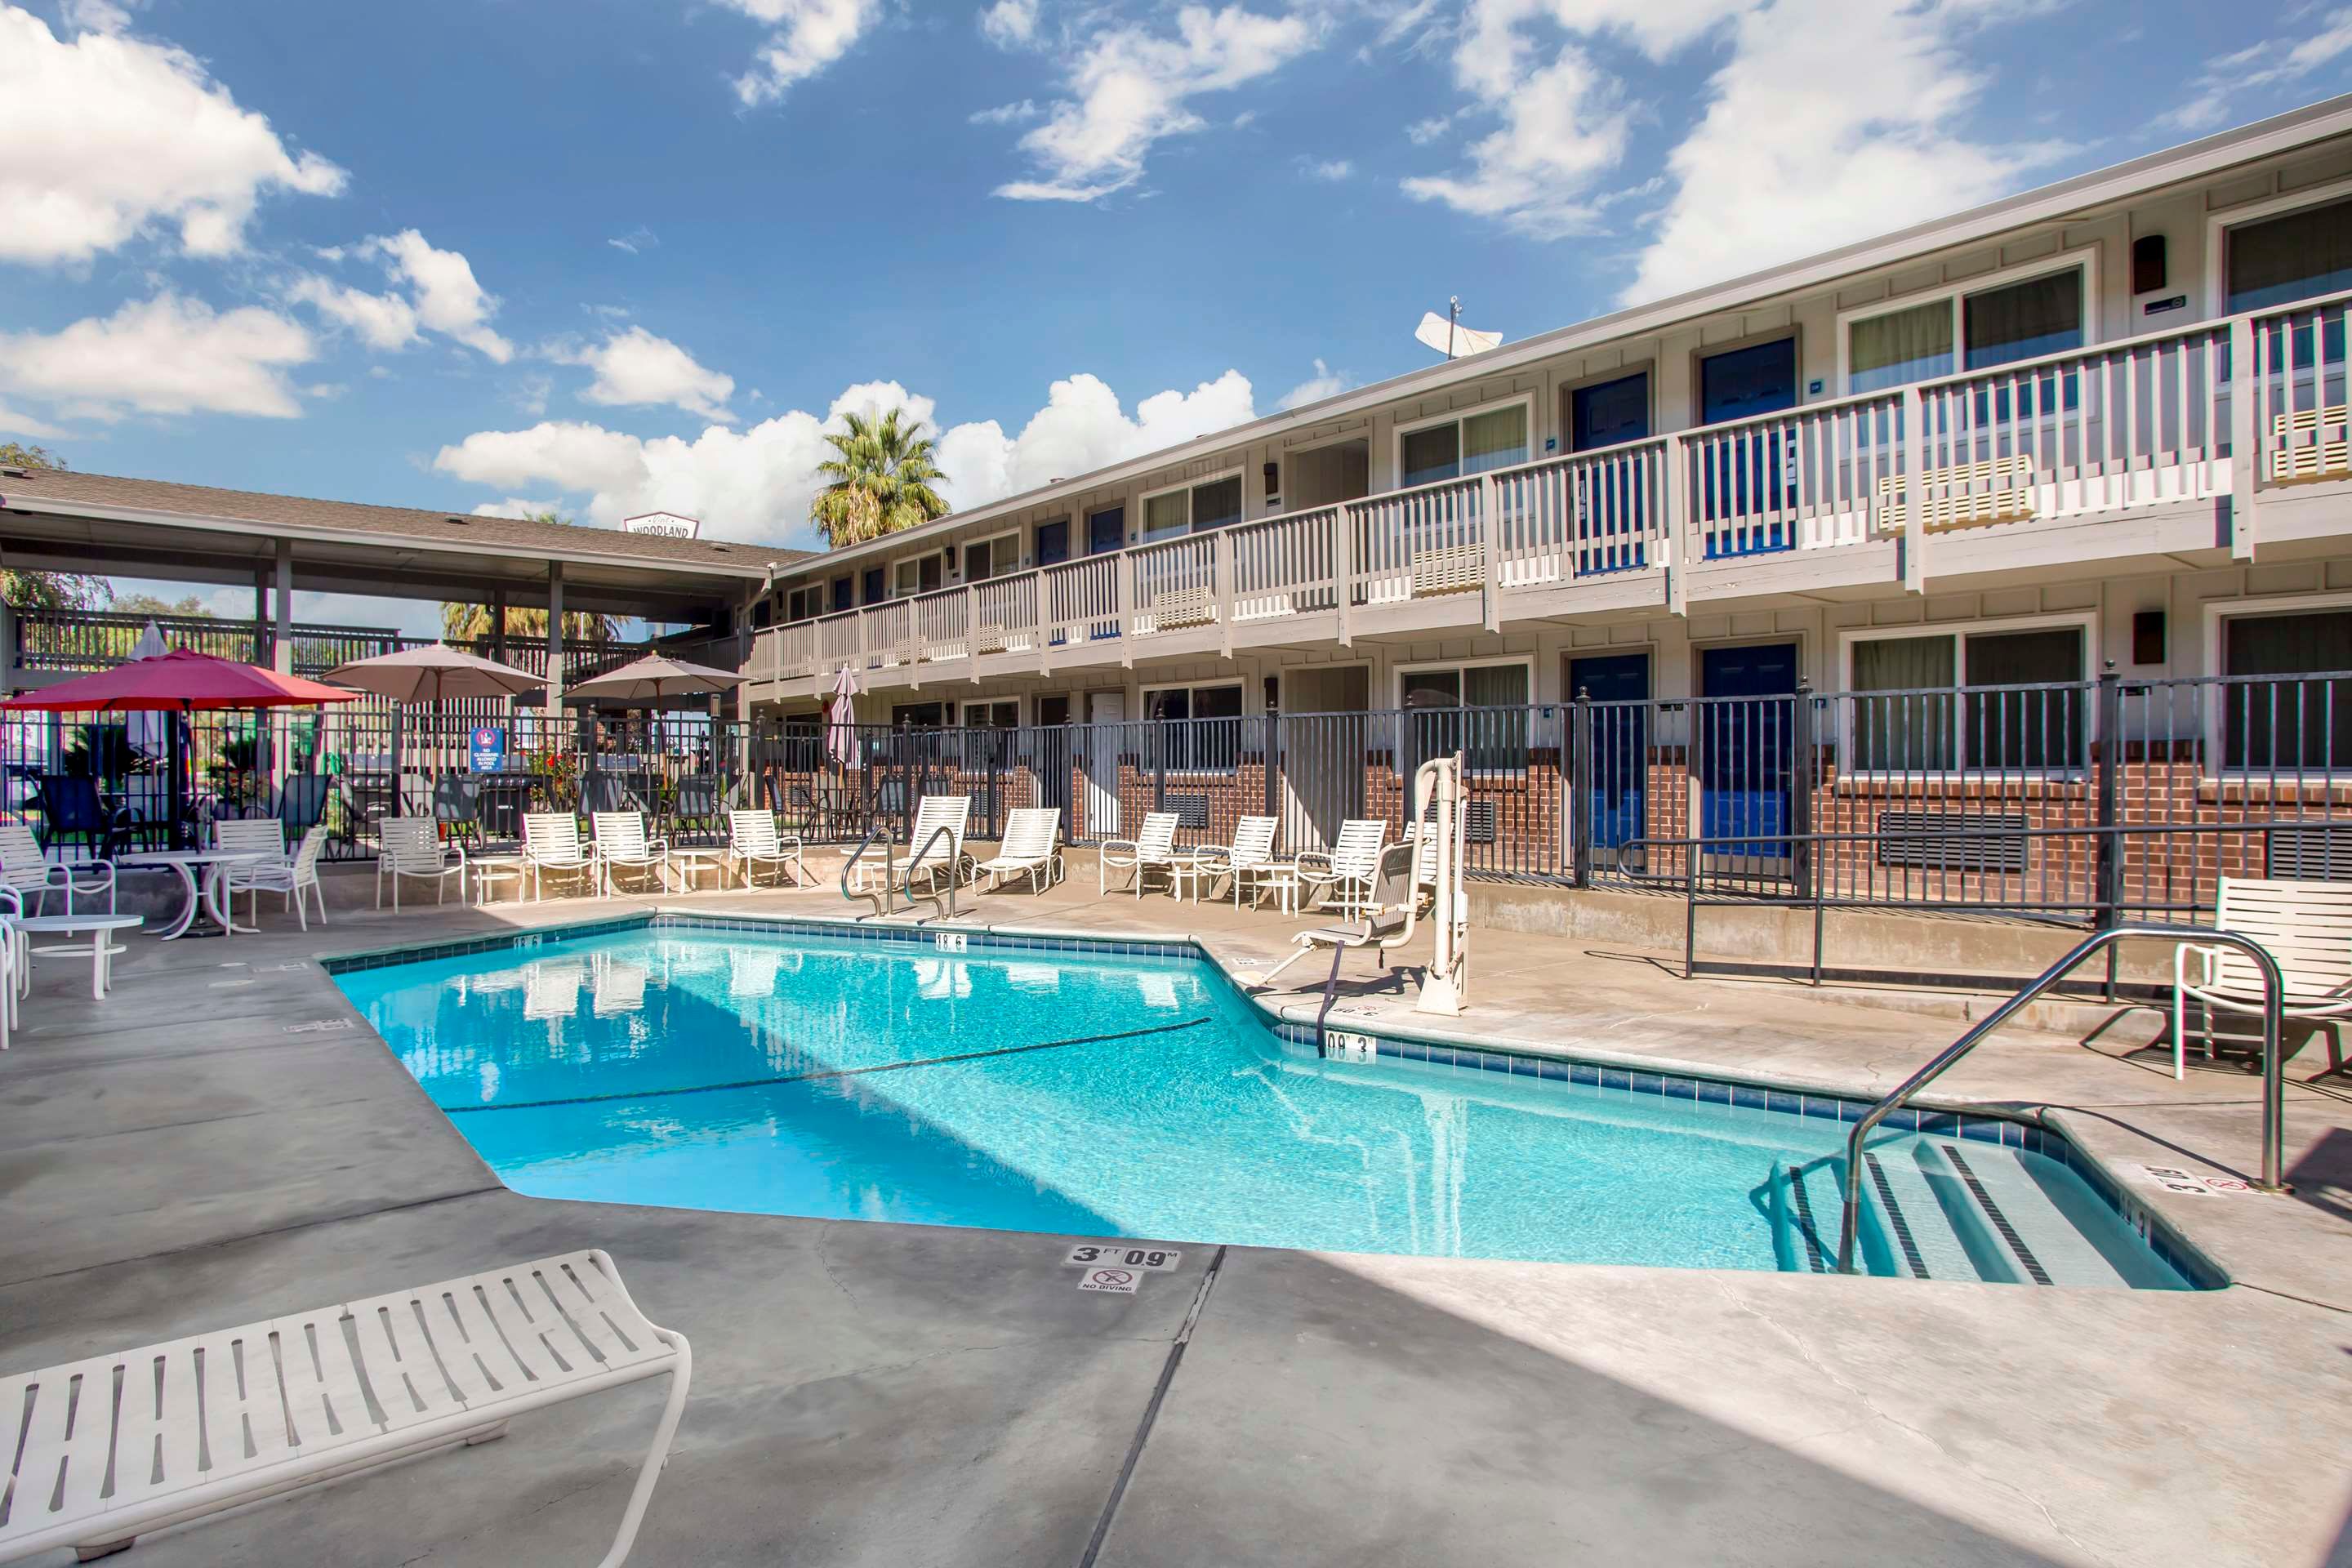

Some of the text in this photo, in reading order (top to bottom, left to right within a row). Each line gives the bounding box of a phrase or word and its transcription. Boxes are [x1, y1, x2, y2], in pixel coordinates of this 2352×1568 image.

[633, 525, 688, 537] WOODLAND
[1072, 1246, 1101, 1262] 3
[1098, 1284, 1133, 1292] DIVING
